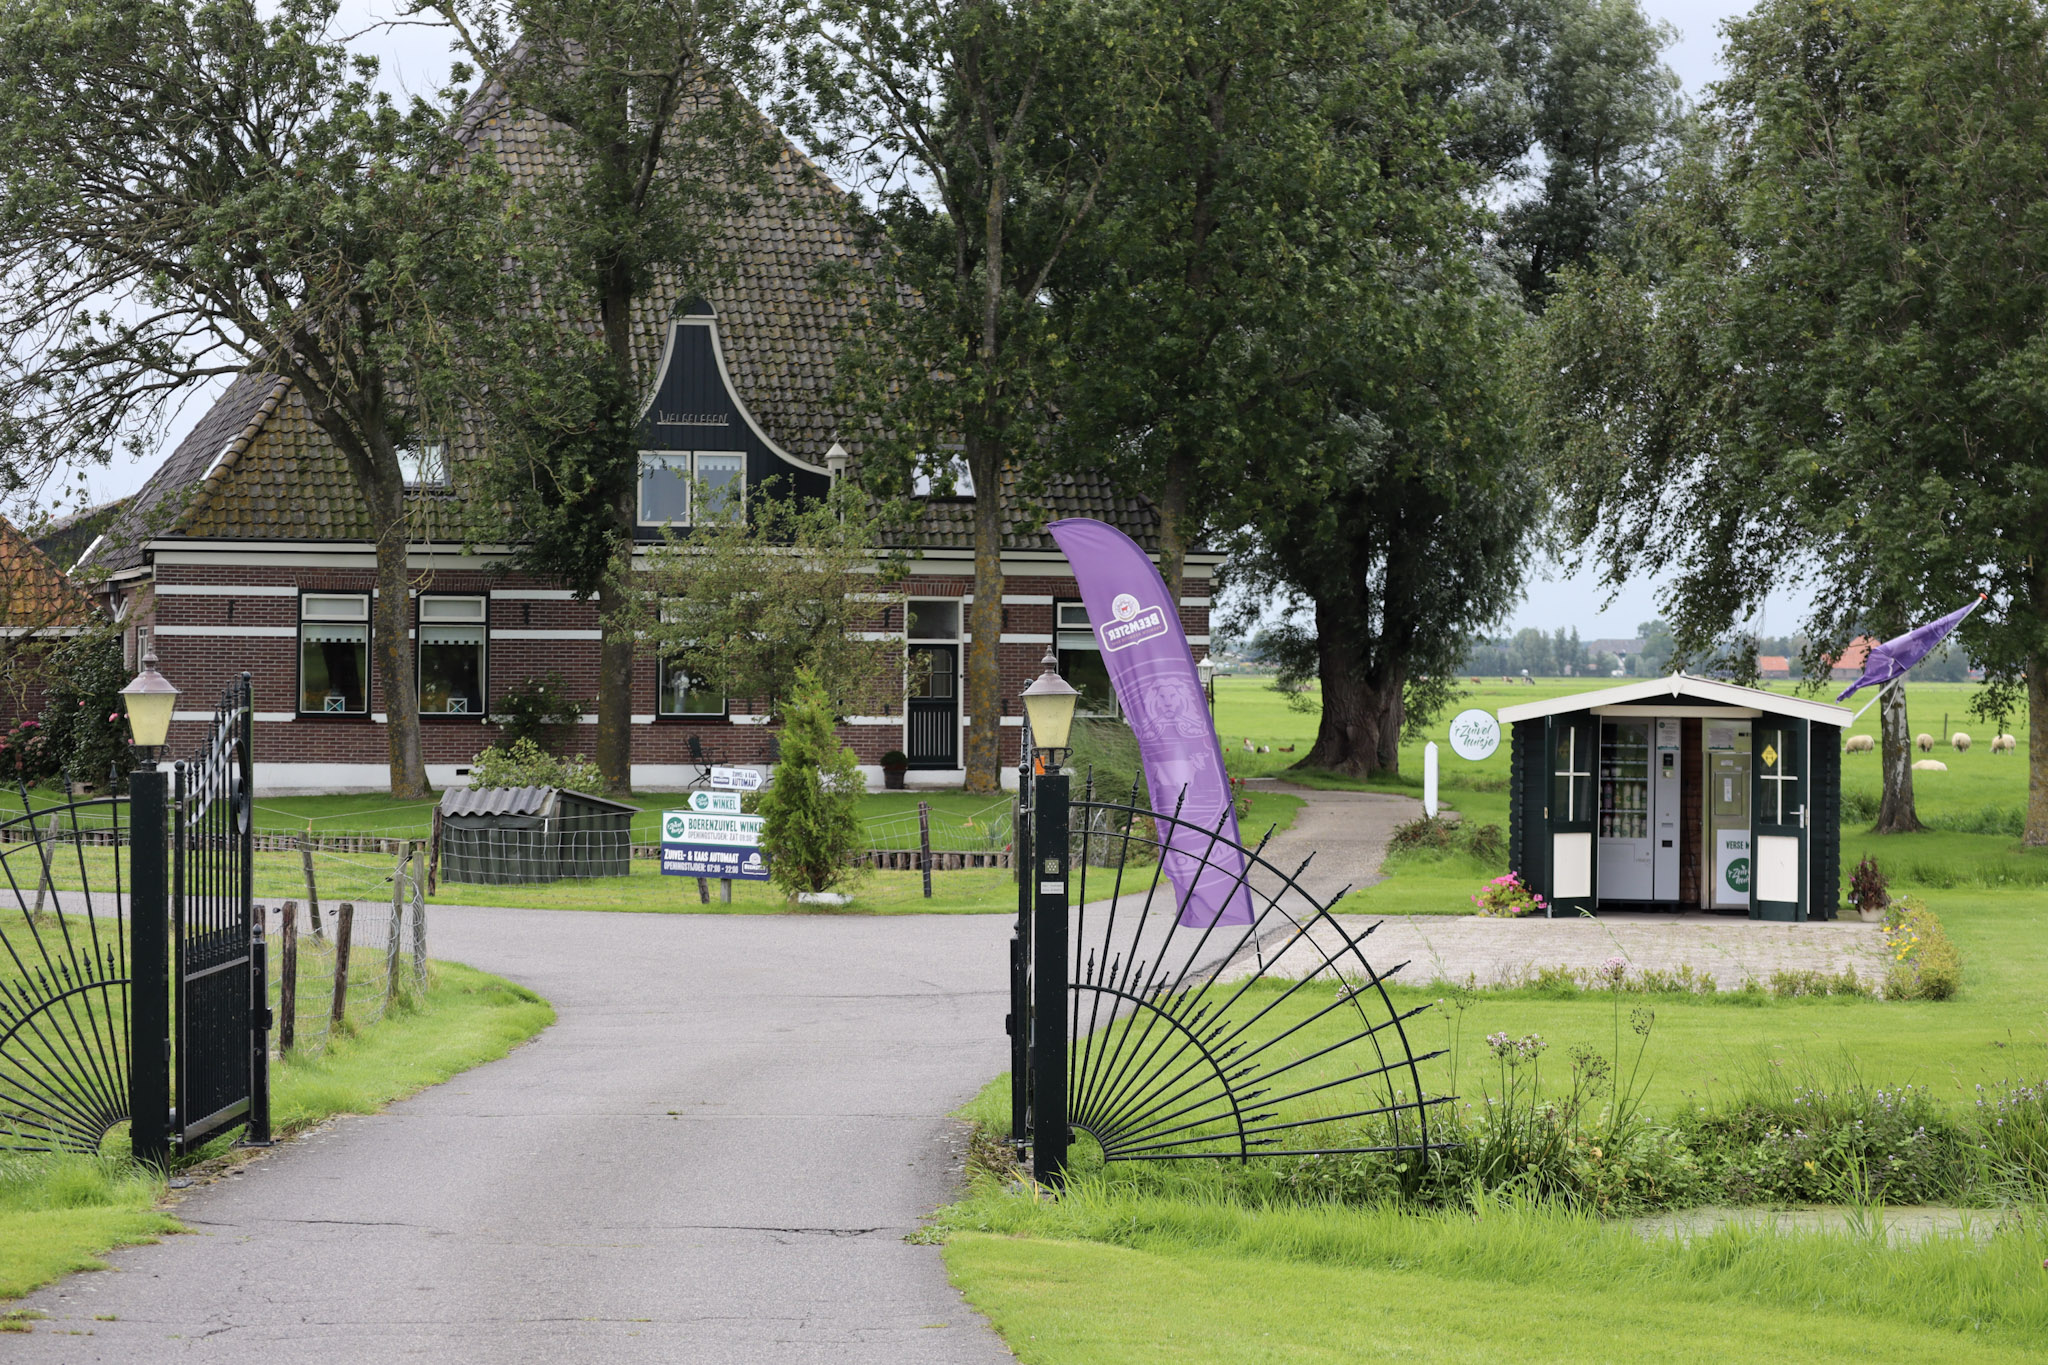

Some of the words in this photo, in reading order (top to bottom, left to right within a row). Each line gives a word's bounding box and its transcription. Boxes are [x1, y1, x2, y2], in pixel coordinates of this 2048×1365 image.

[659, 409, 728, 423] WELGELEGEN
[1460, 724, 1493, 738] Zuivel
[1463, 735, 1495, 750] huisje
[732, 778, 757, 788] AUTOMAAT
[712, 799, 737, 810] WINKEL
[688, 818, 738, 832] BOERENZUIVEL
[740, 821, 763, 833] WINKE
[729, 833, 739, 841] ZAT
[1726, 840, 1744, 850] VERSE
[664, 848, 687, 861] ZUIVEL-
[687, 850, 693, 861] &
[693, 850, 709, 862] KAAS
[709, 852, 739, 864] AUTOMAAT
